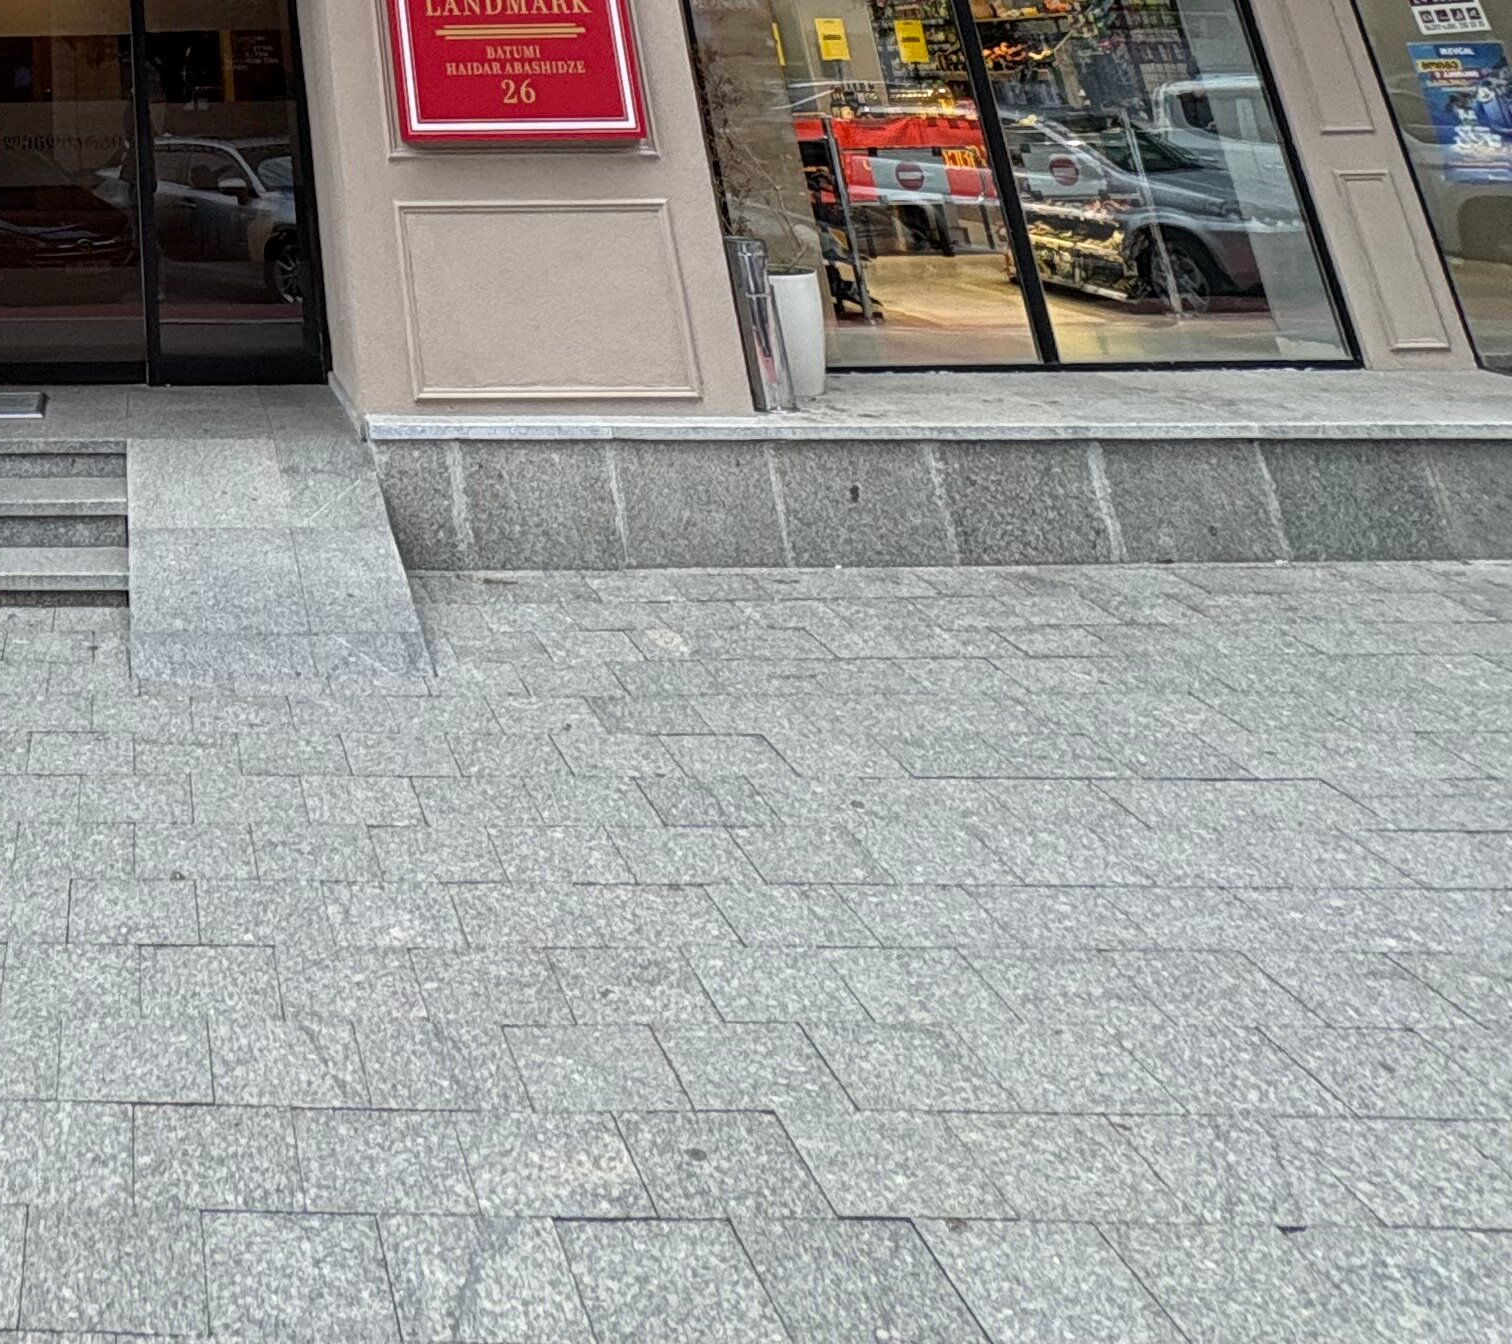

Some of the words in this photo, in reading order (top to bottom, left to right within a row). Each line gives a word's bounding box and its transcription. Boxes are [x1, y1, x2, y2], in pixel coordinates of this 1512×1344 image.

[486, 44, 542, 60] BATUMI
[445, 61, 503, 76] HAIDAR
[503, 59, 587, 75] ABASHIDZE
[500, 78, 537, 105] 26
